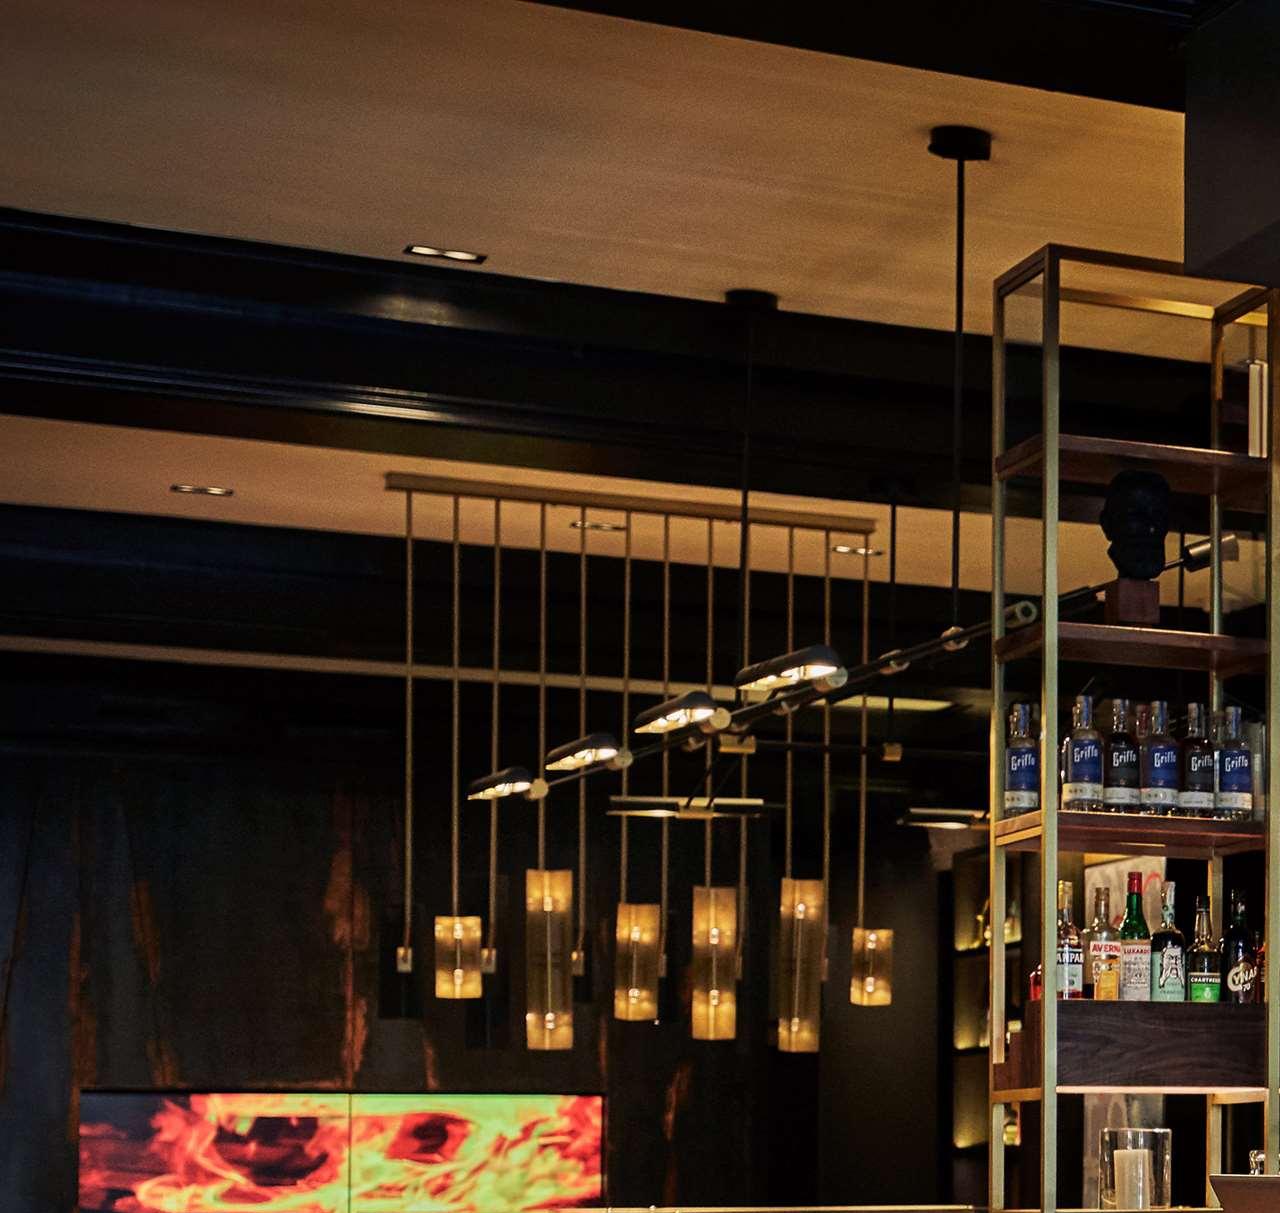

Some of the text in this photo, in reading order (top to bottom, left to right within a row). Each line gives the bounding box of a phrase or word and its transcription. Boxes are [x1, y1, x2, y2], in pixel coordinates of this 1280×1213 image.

[1074, 745, 1099, 762] Griffo
[1113, 750, 1137, 767] Griffo
[1154, 752, 1177, 768] Griffo
[1011, 753, 1036, 771] Griffo
[1191, 755, 1214, 771] Griffo
[1224, 756, 1249, 772] Griffo
